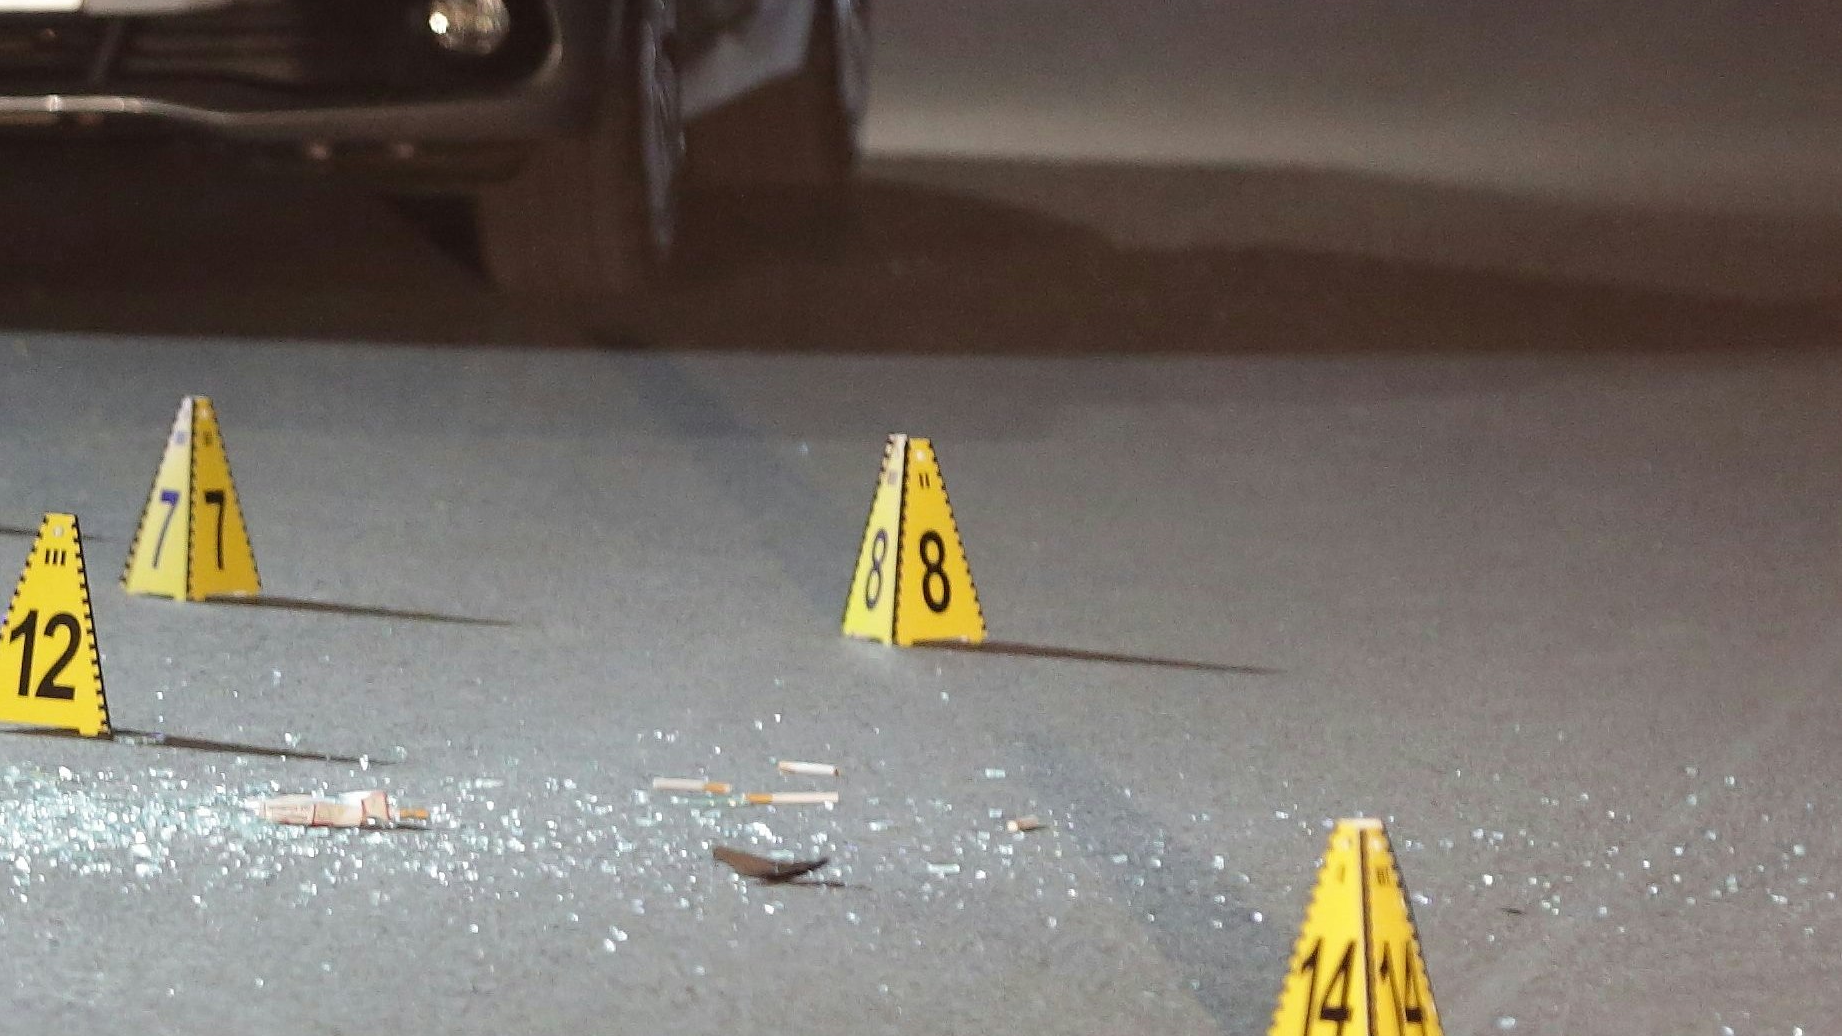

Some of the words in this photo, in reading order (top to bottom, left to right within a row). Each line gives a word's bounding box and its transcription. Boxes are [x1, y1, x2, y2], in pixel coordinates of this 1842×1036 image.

[154, 490, 180, 569] 7
[206, 489, 226, 570] 7
[865, 529, 887, 609] 8
[920, 531, 951, 613] 8
[10, 610, 81, 700] 12
[1301, 938, 1356, 1036] 14
[1380, 940, 1426, 1036] 14
